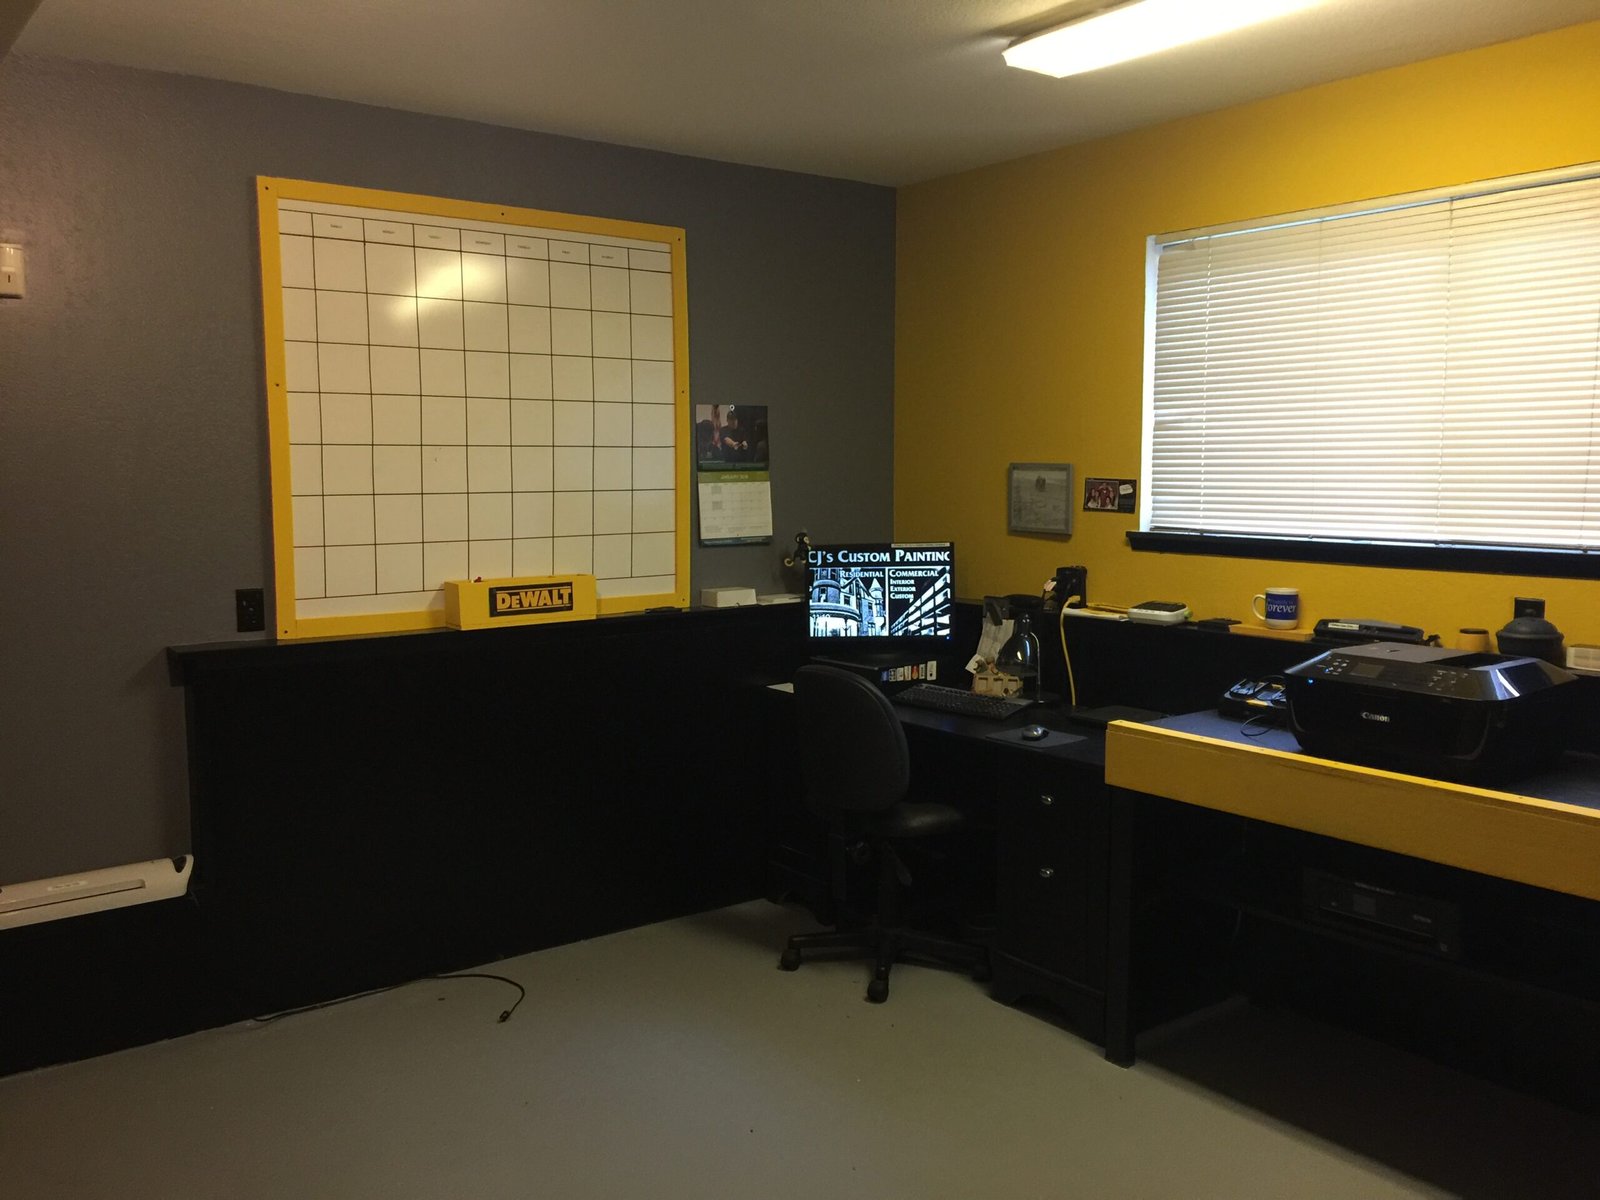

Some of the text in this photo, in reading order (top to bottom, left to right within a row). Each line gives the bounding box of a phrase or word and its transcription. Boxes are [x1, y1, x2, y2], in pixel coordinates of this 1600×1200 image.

[808, 550, 834, 566] CJ's
[889, 569, 939, 577] COMMERCIAL
[1267, 602, 1296, 613] orever
[1361, 711, 1390, 722] Canon
